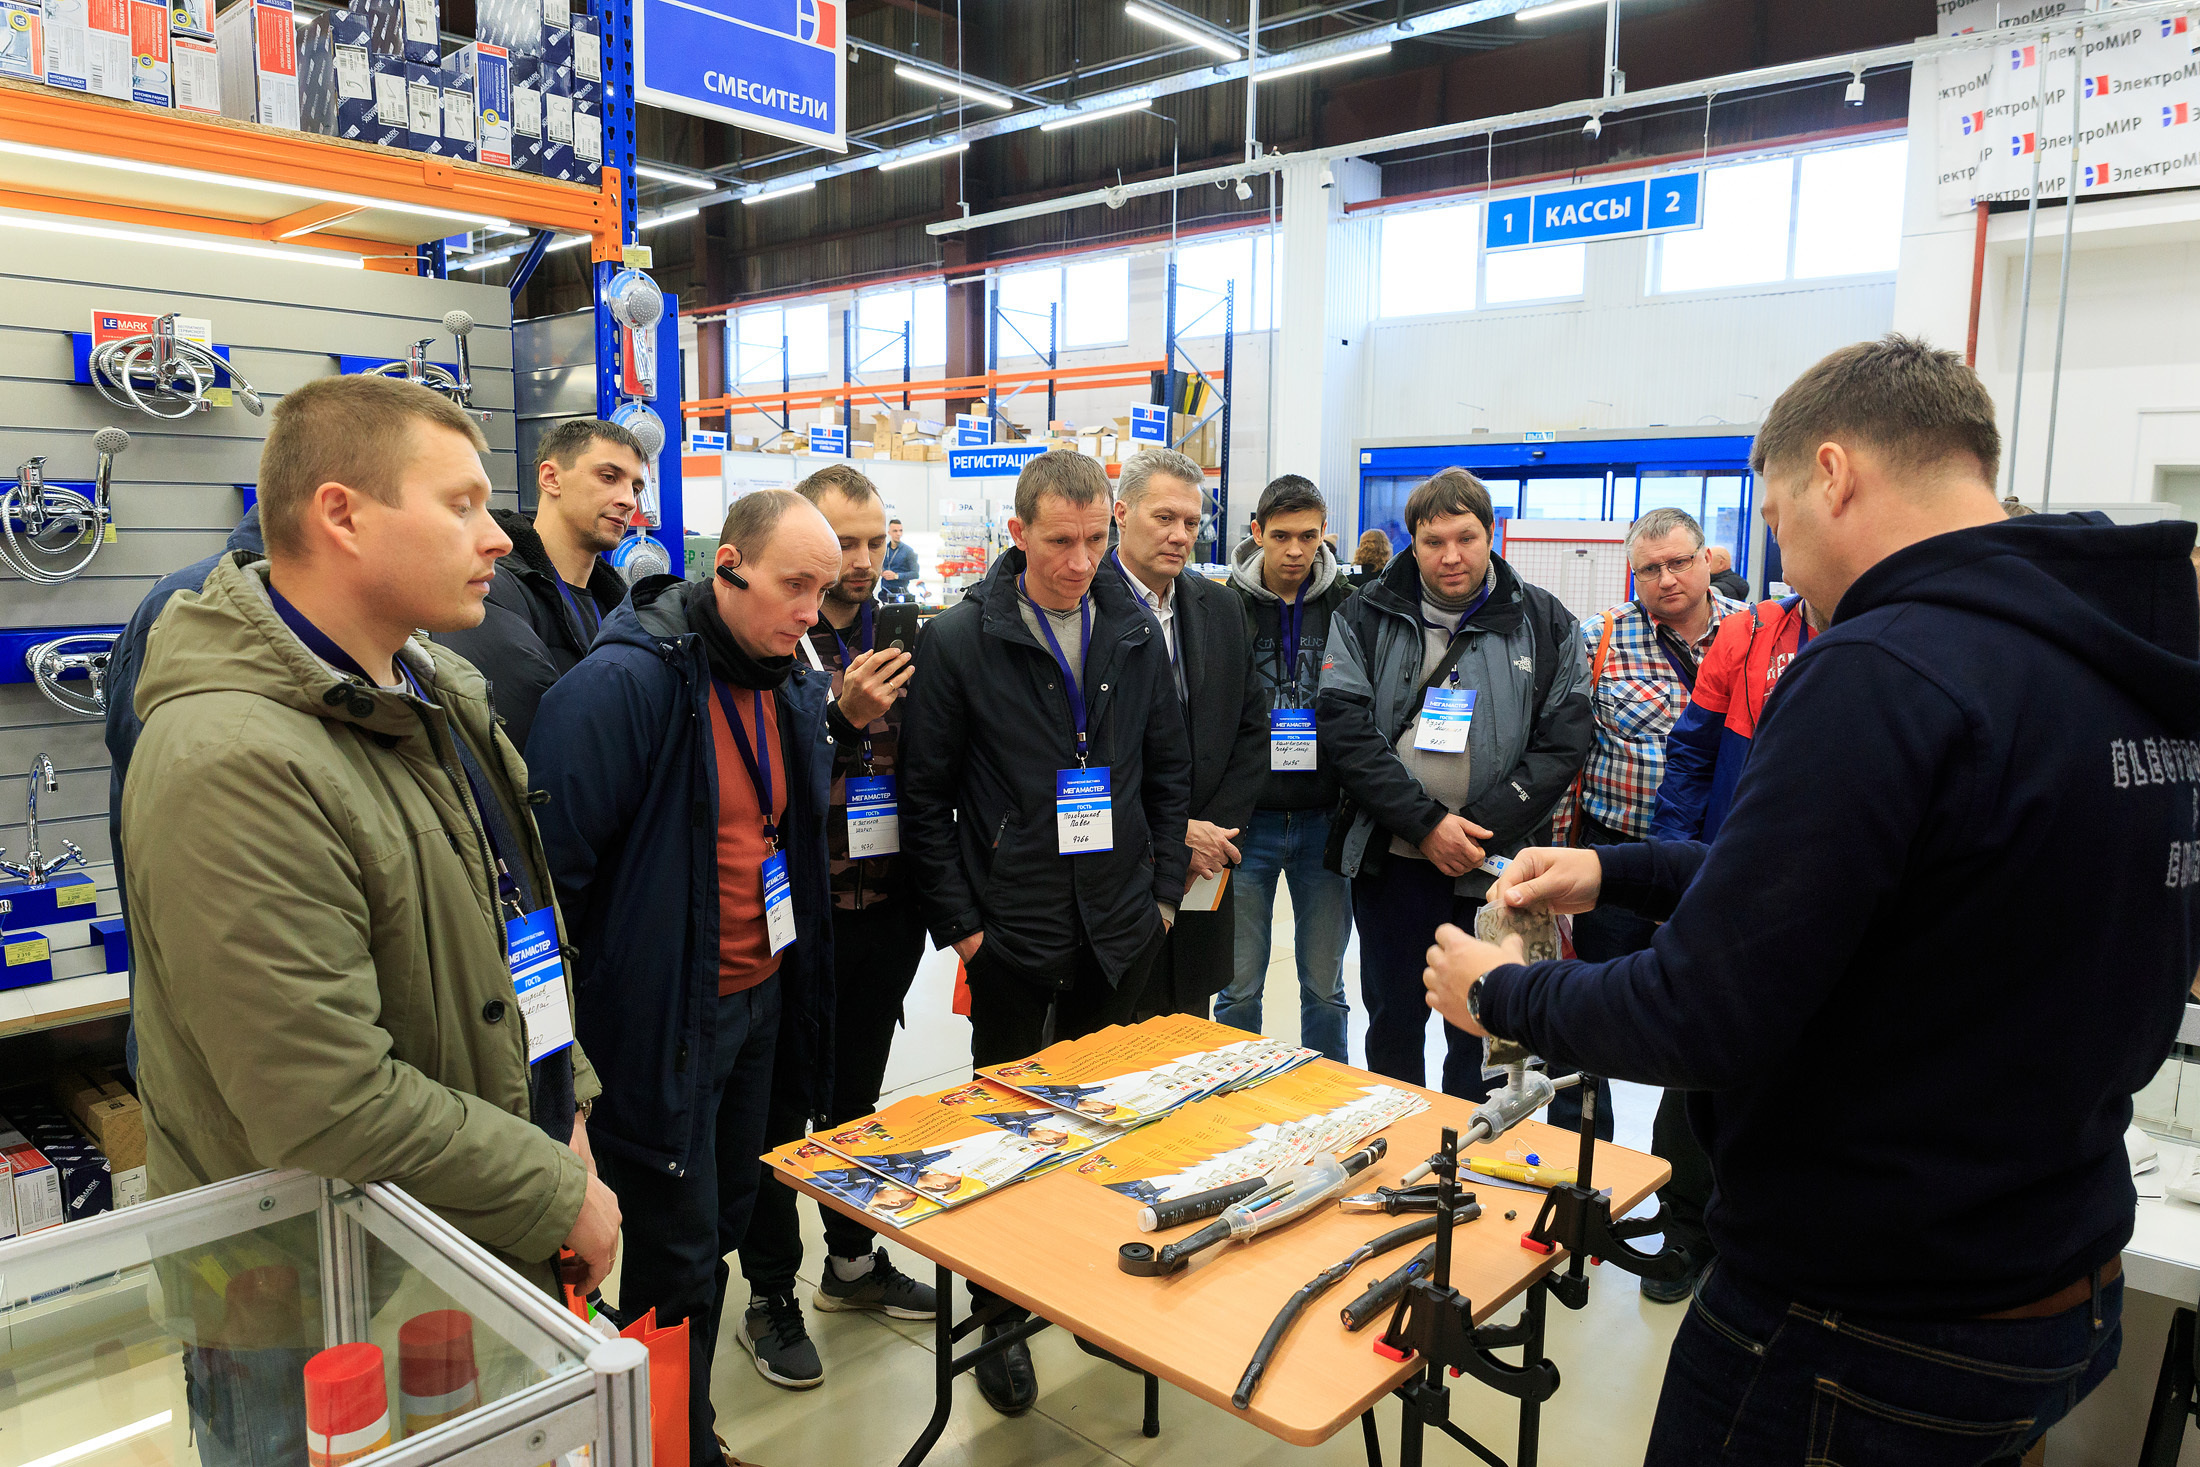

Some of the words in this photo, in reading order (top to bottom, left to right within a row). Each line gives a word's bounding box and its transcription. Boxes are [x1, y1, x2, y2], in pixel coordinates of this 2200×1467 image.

[703, 70, 828, 121] СМЕСИТЕЛИ
[1664, 191, 1681, 213] 2
[1545, 196, 1631, 228] КАССЫ
[1503, 213, 1513, 233] 1
[102, 317, 149, 333] LEMARK
[953, 453, 1042, 469] РЕГИСТРАЦИ
[959, 503, 974, 511] ЭРА
[1429, 700, 1469, 709] МЕГАМАСТЕР
[851, 792, 891, 802] МЕГАМАСТЕР
[1063, 785, 1105, 795] МЕГАМАСТЕР
[508, 939, 551, 965] МЕГАМАСТЕР
[524, 975, 542, 988] ГОСТЬ
[71, 1178, 101, 1210] LEMARK
